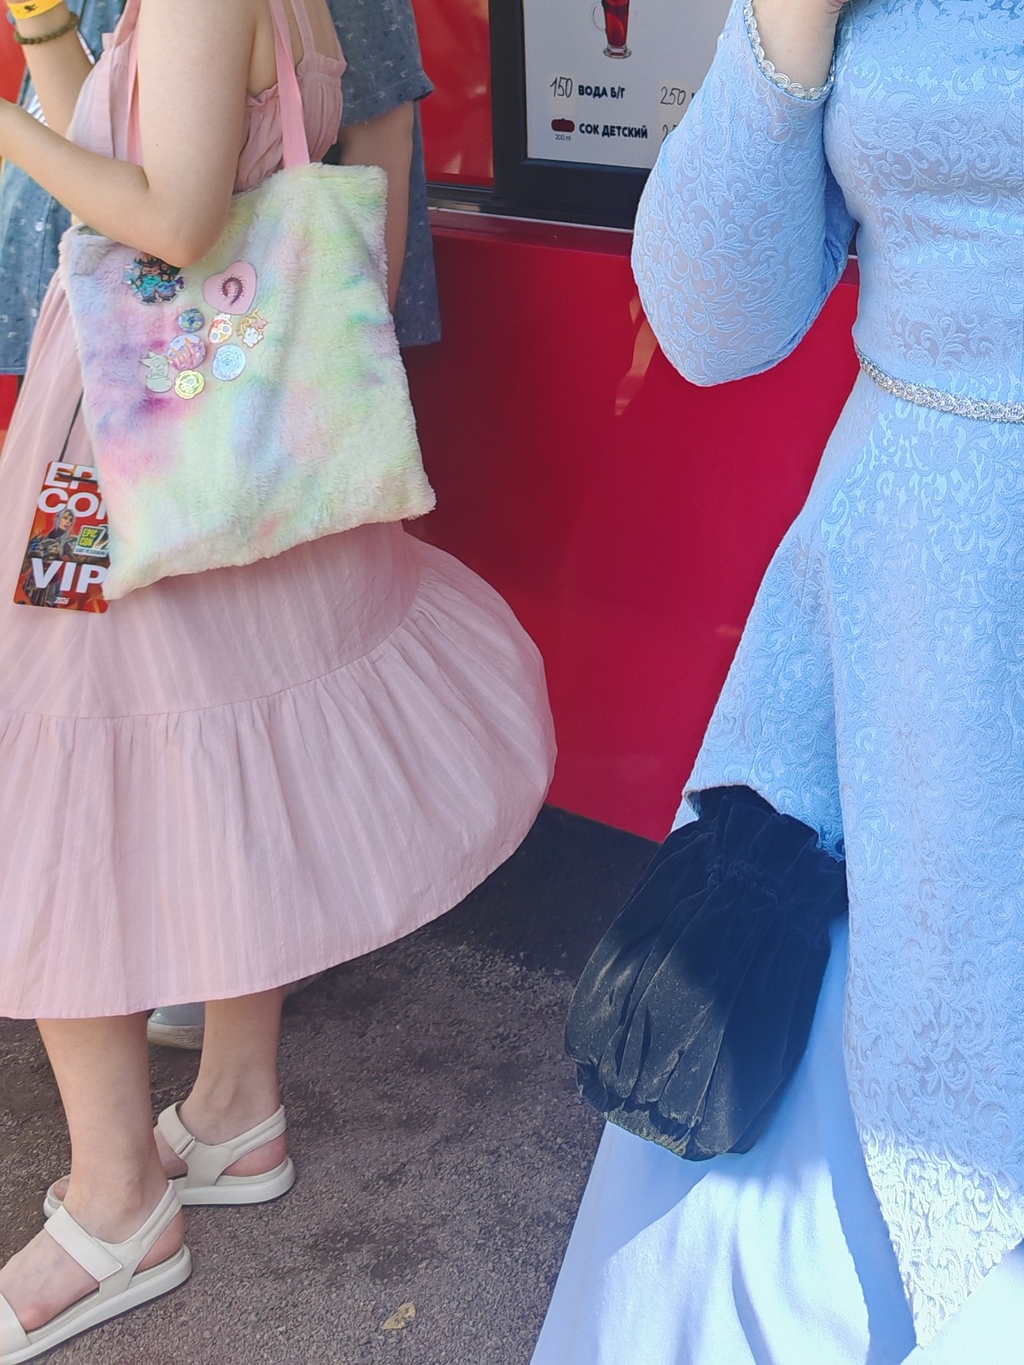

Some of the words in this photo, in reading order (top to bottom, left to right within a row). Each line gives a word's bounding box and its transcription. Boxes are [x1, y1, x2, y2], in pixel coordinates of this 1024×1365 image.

[550, 76, 573, 98] 150
[578, 85, 608, 99] ВОДА
[610, 86, 625, 99] Б/Г
[660, 86, 686, 105] 250
[579, 123, 600, 135] СОК
[602, 125, 648, 139] ДЕТСКИЙ
[31, 558, 108, 593] VIP
